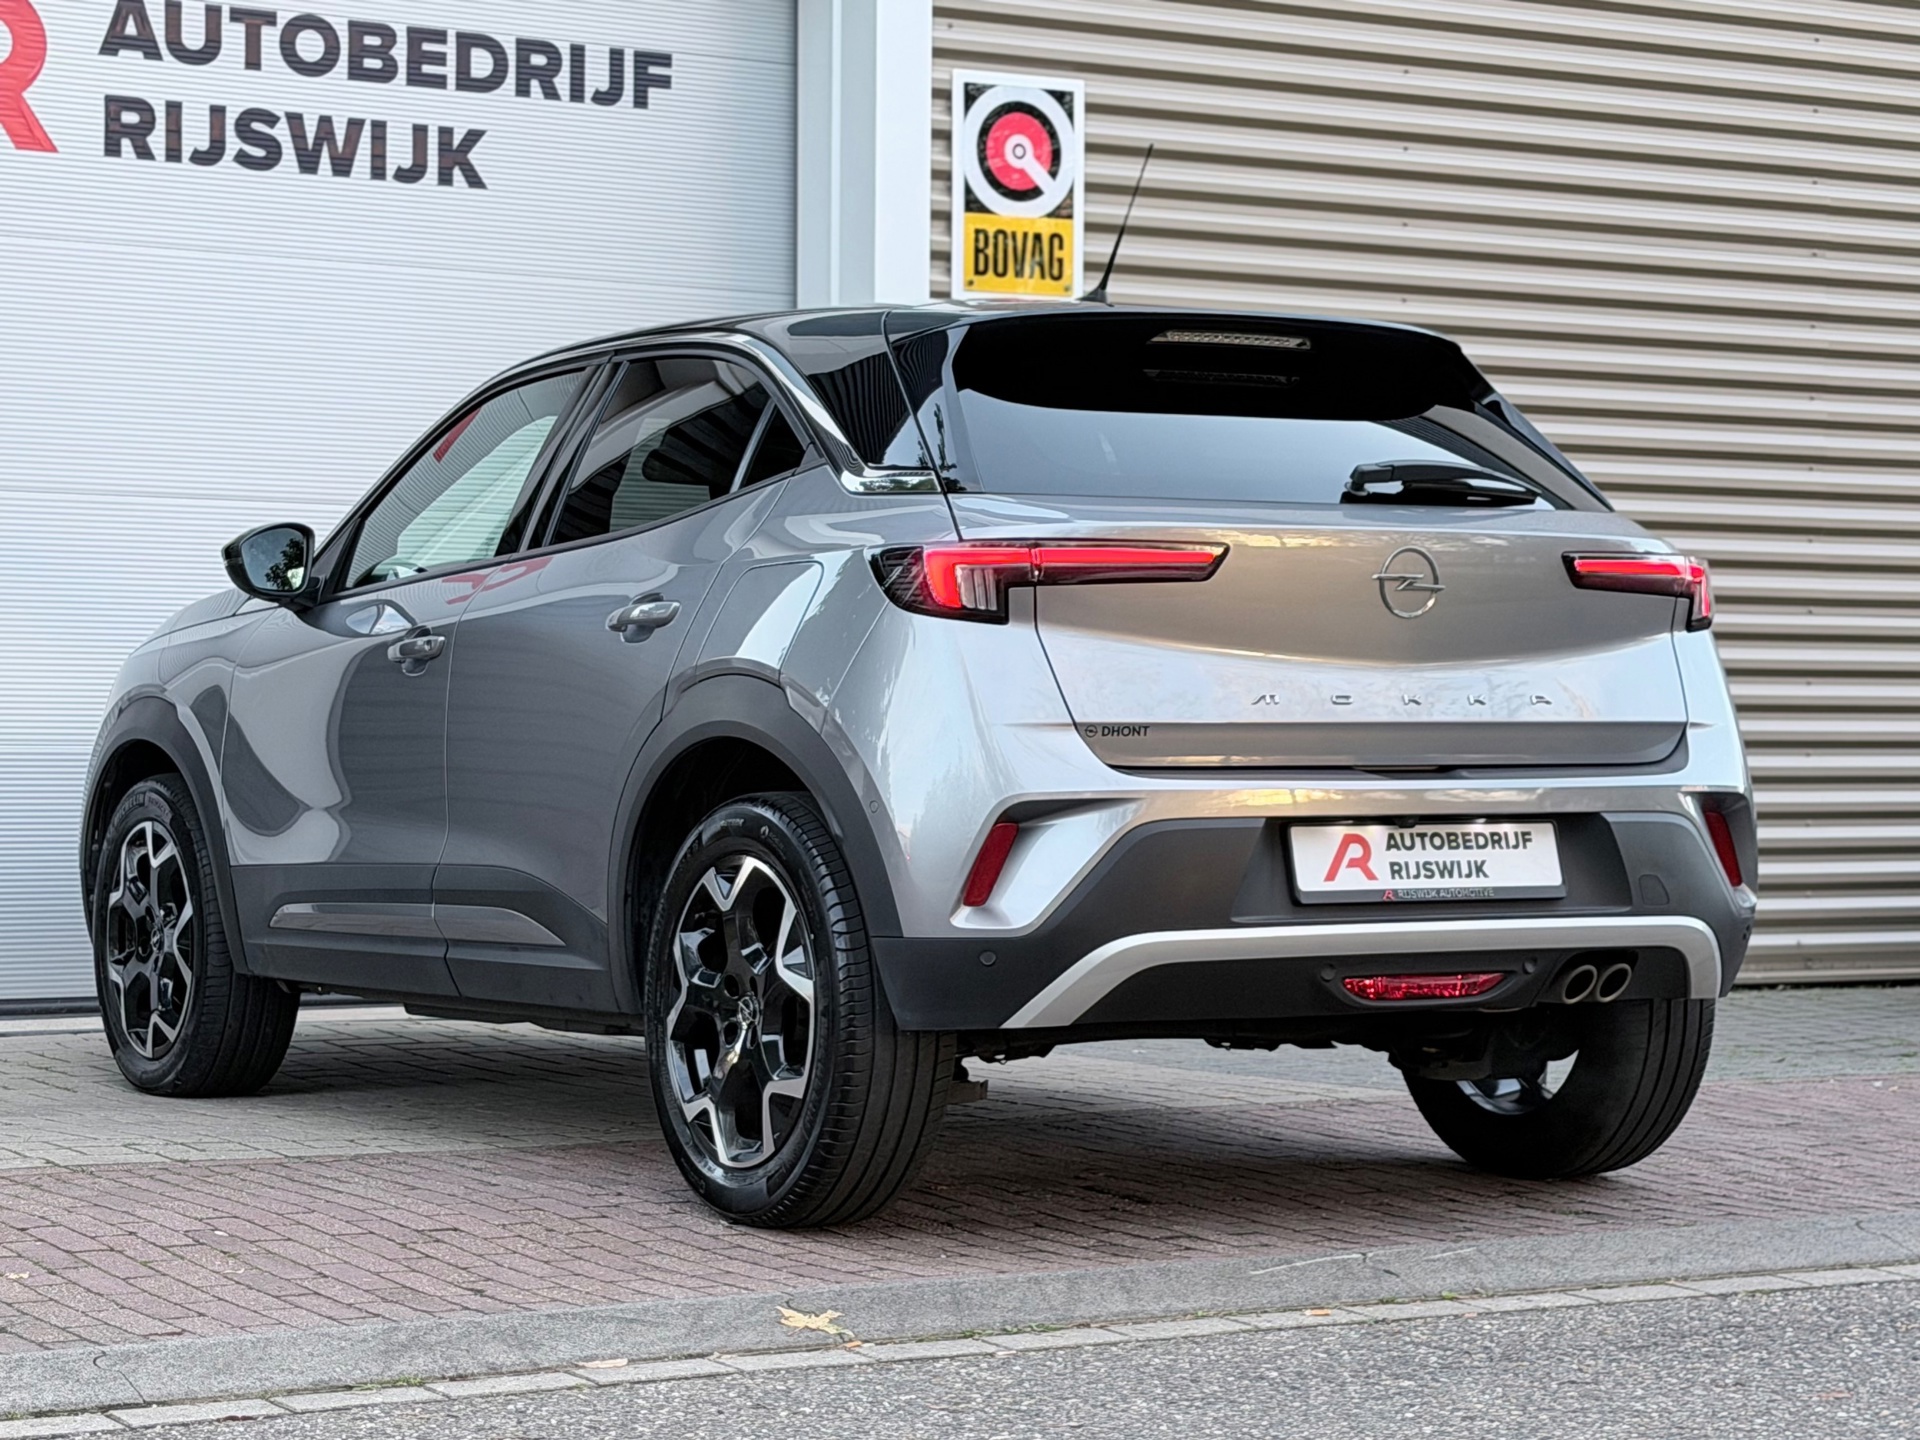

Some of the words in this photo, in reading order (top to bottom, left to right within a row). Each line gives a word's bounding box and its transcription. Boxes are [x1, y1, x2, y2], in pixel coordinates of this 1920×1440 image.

[98, 0, 673, 109] AUTOBEDRIJF
[103, 94, 488, 190] RIJSWIJK
[973, 227, 1065, 282] BOVAG
[1250, 693, 1553, 706] MOKKA
[1101, 725, 1151, 737] DHONT
[1385, 830, 1534, 851] AUTOBEDRIJF
[1388, 859, 1490, 880] RIJSWIJK
[1397, 889, 1438, 899] RIJSWIJK
[1439, 887, 1495, 898] AUTOMOTIVE
